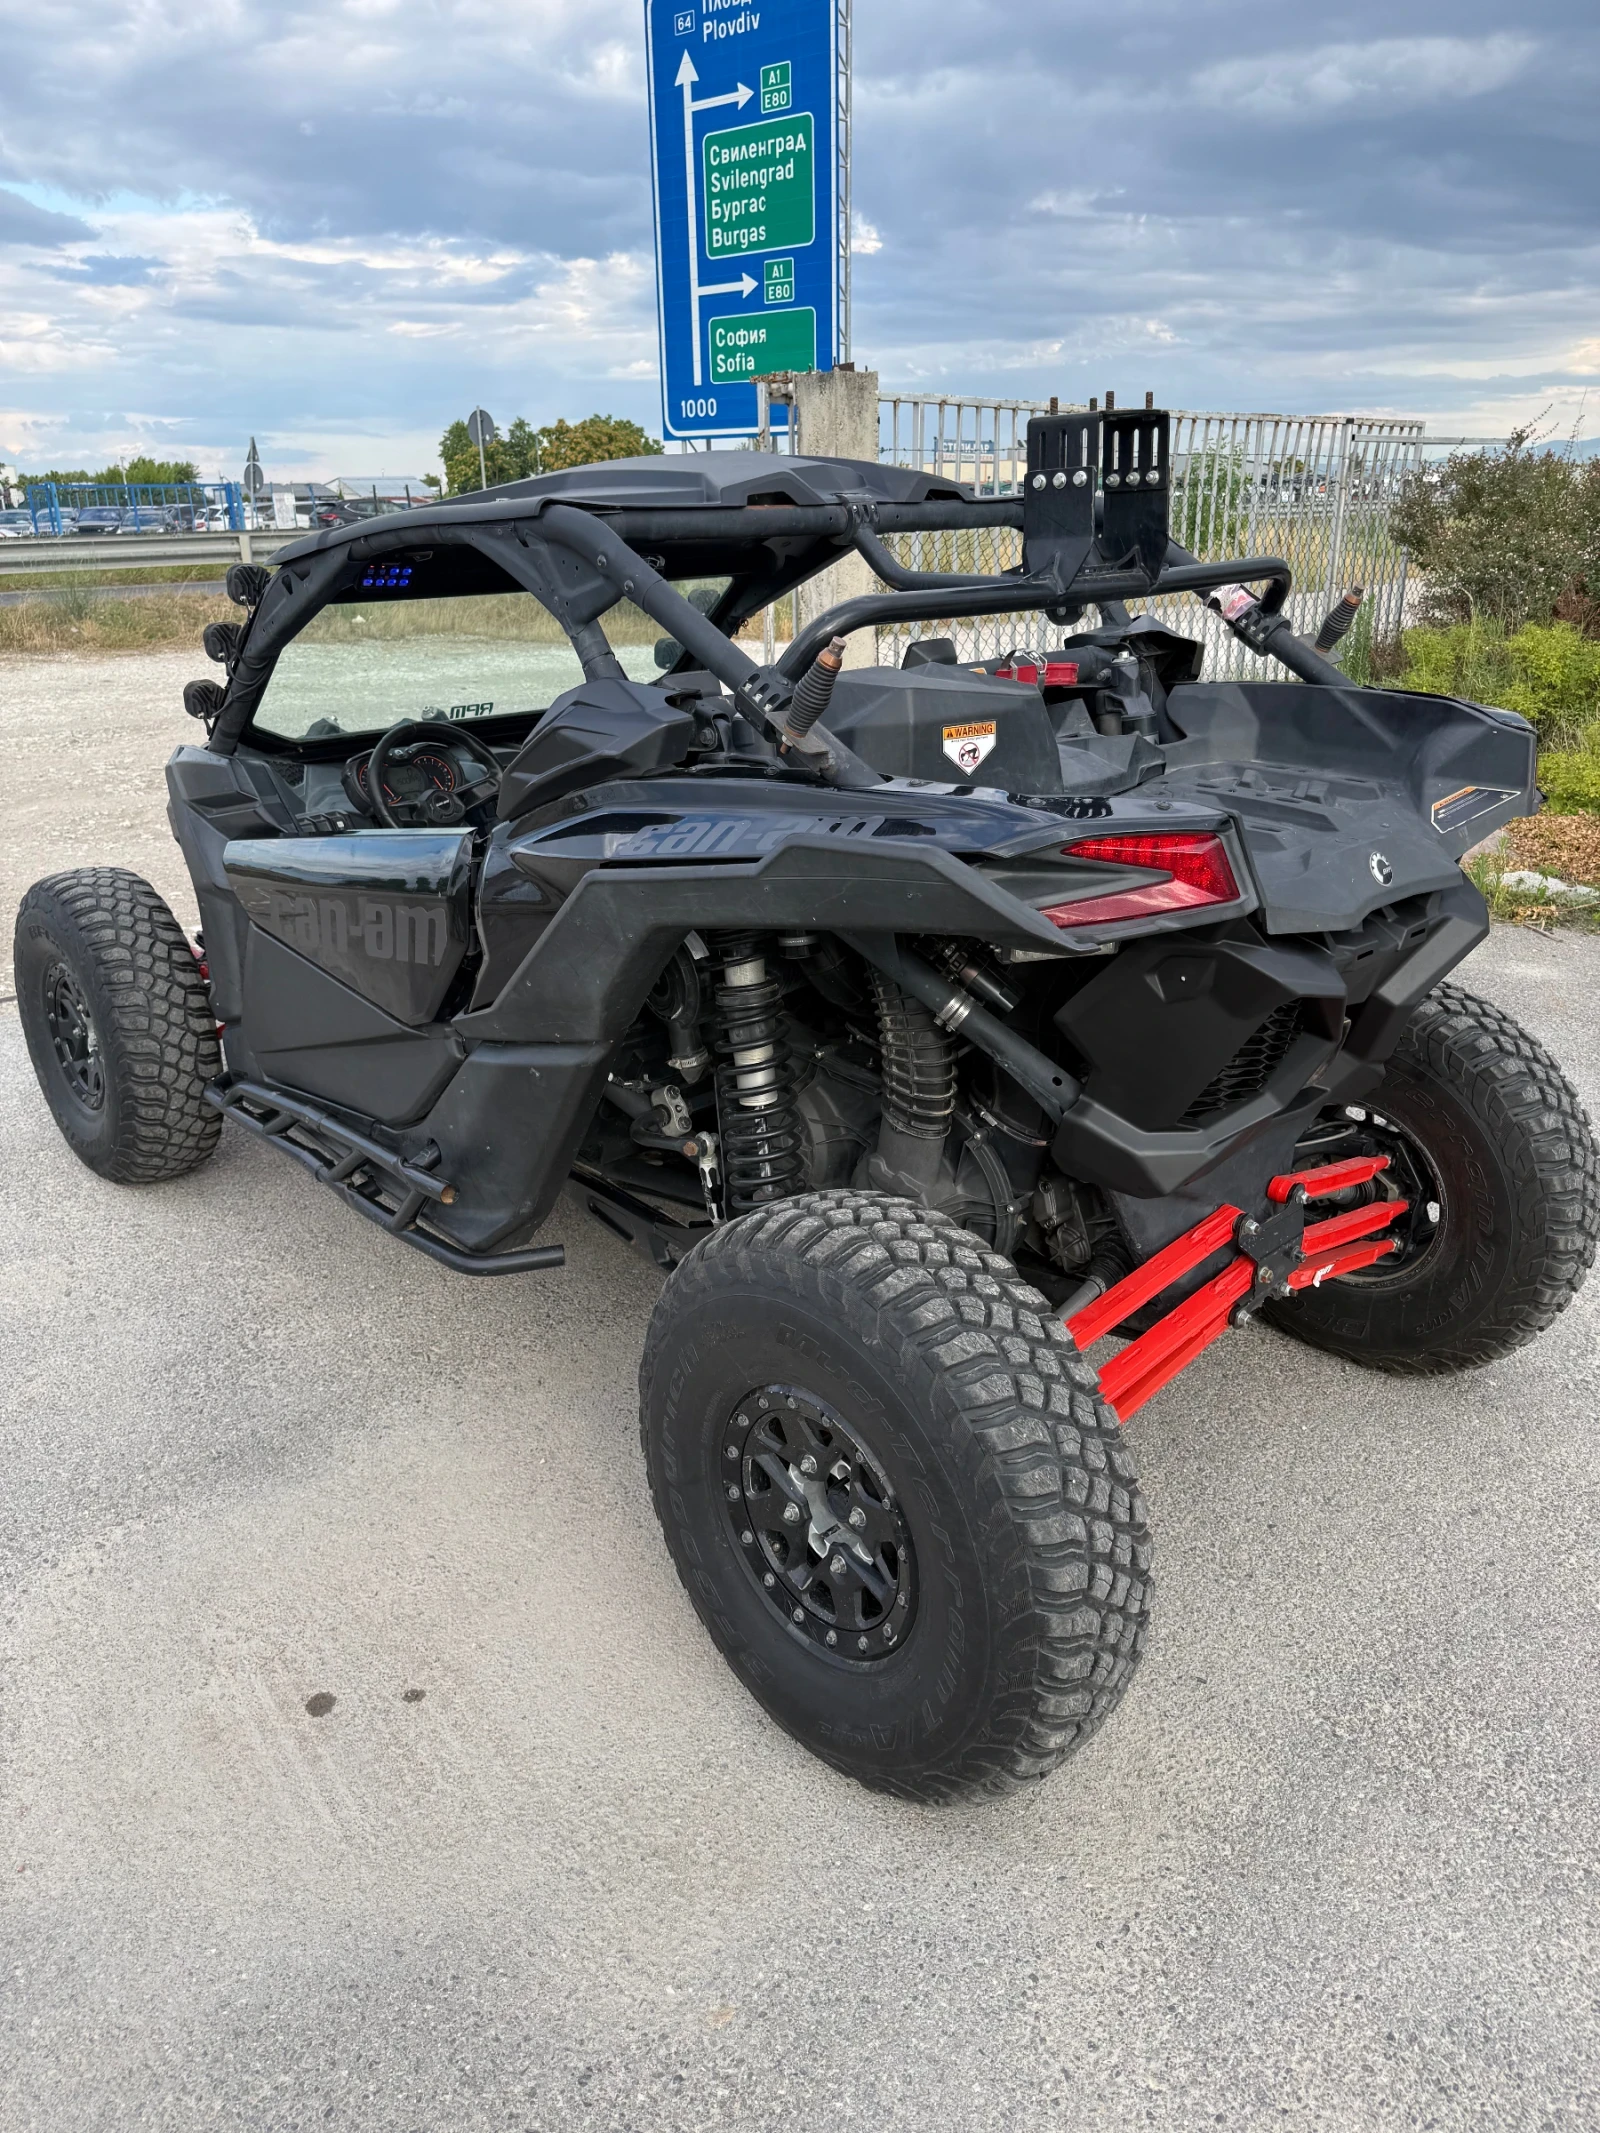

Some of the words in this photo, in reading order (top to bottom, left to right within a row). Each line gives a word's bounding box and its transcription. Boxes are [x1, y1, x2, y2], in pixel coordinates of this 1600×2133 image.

[677, 15, 692, 31] 64
[703, 11, 760, 43] Plovdiv
[768, 69, 781, 86] A1
[764, 91, 787, 109] E80
[710, 132, 806, 166] Свиленград
[711, 158, 794, 193] Svilengrad
[711, 196, 766, 223] Бургас
[712, 226, 766, 248] Burgas
[772, 264, 784, 279] A1
[768, 284, 790, 300] E80
[715, 328, 766, 348] София
[716, 353, 755, 373] Sofia
[681, 398, 717, 418] 1000
[954, 723, 993, 737] WARNING
